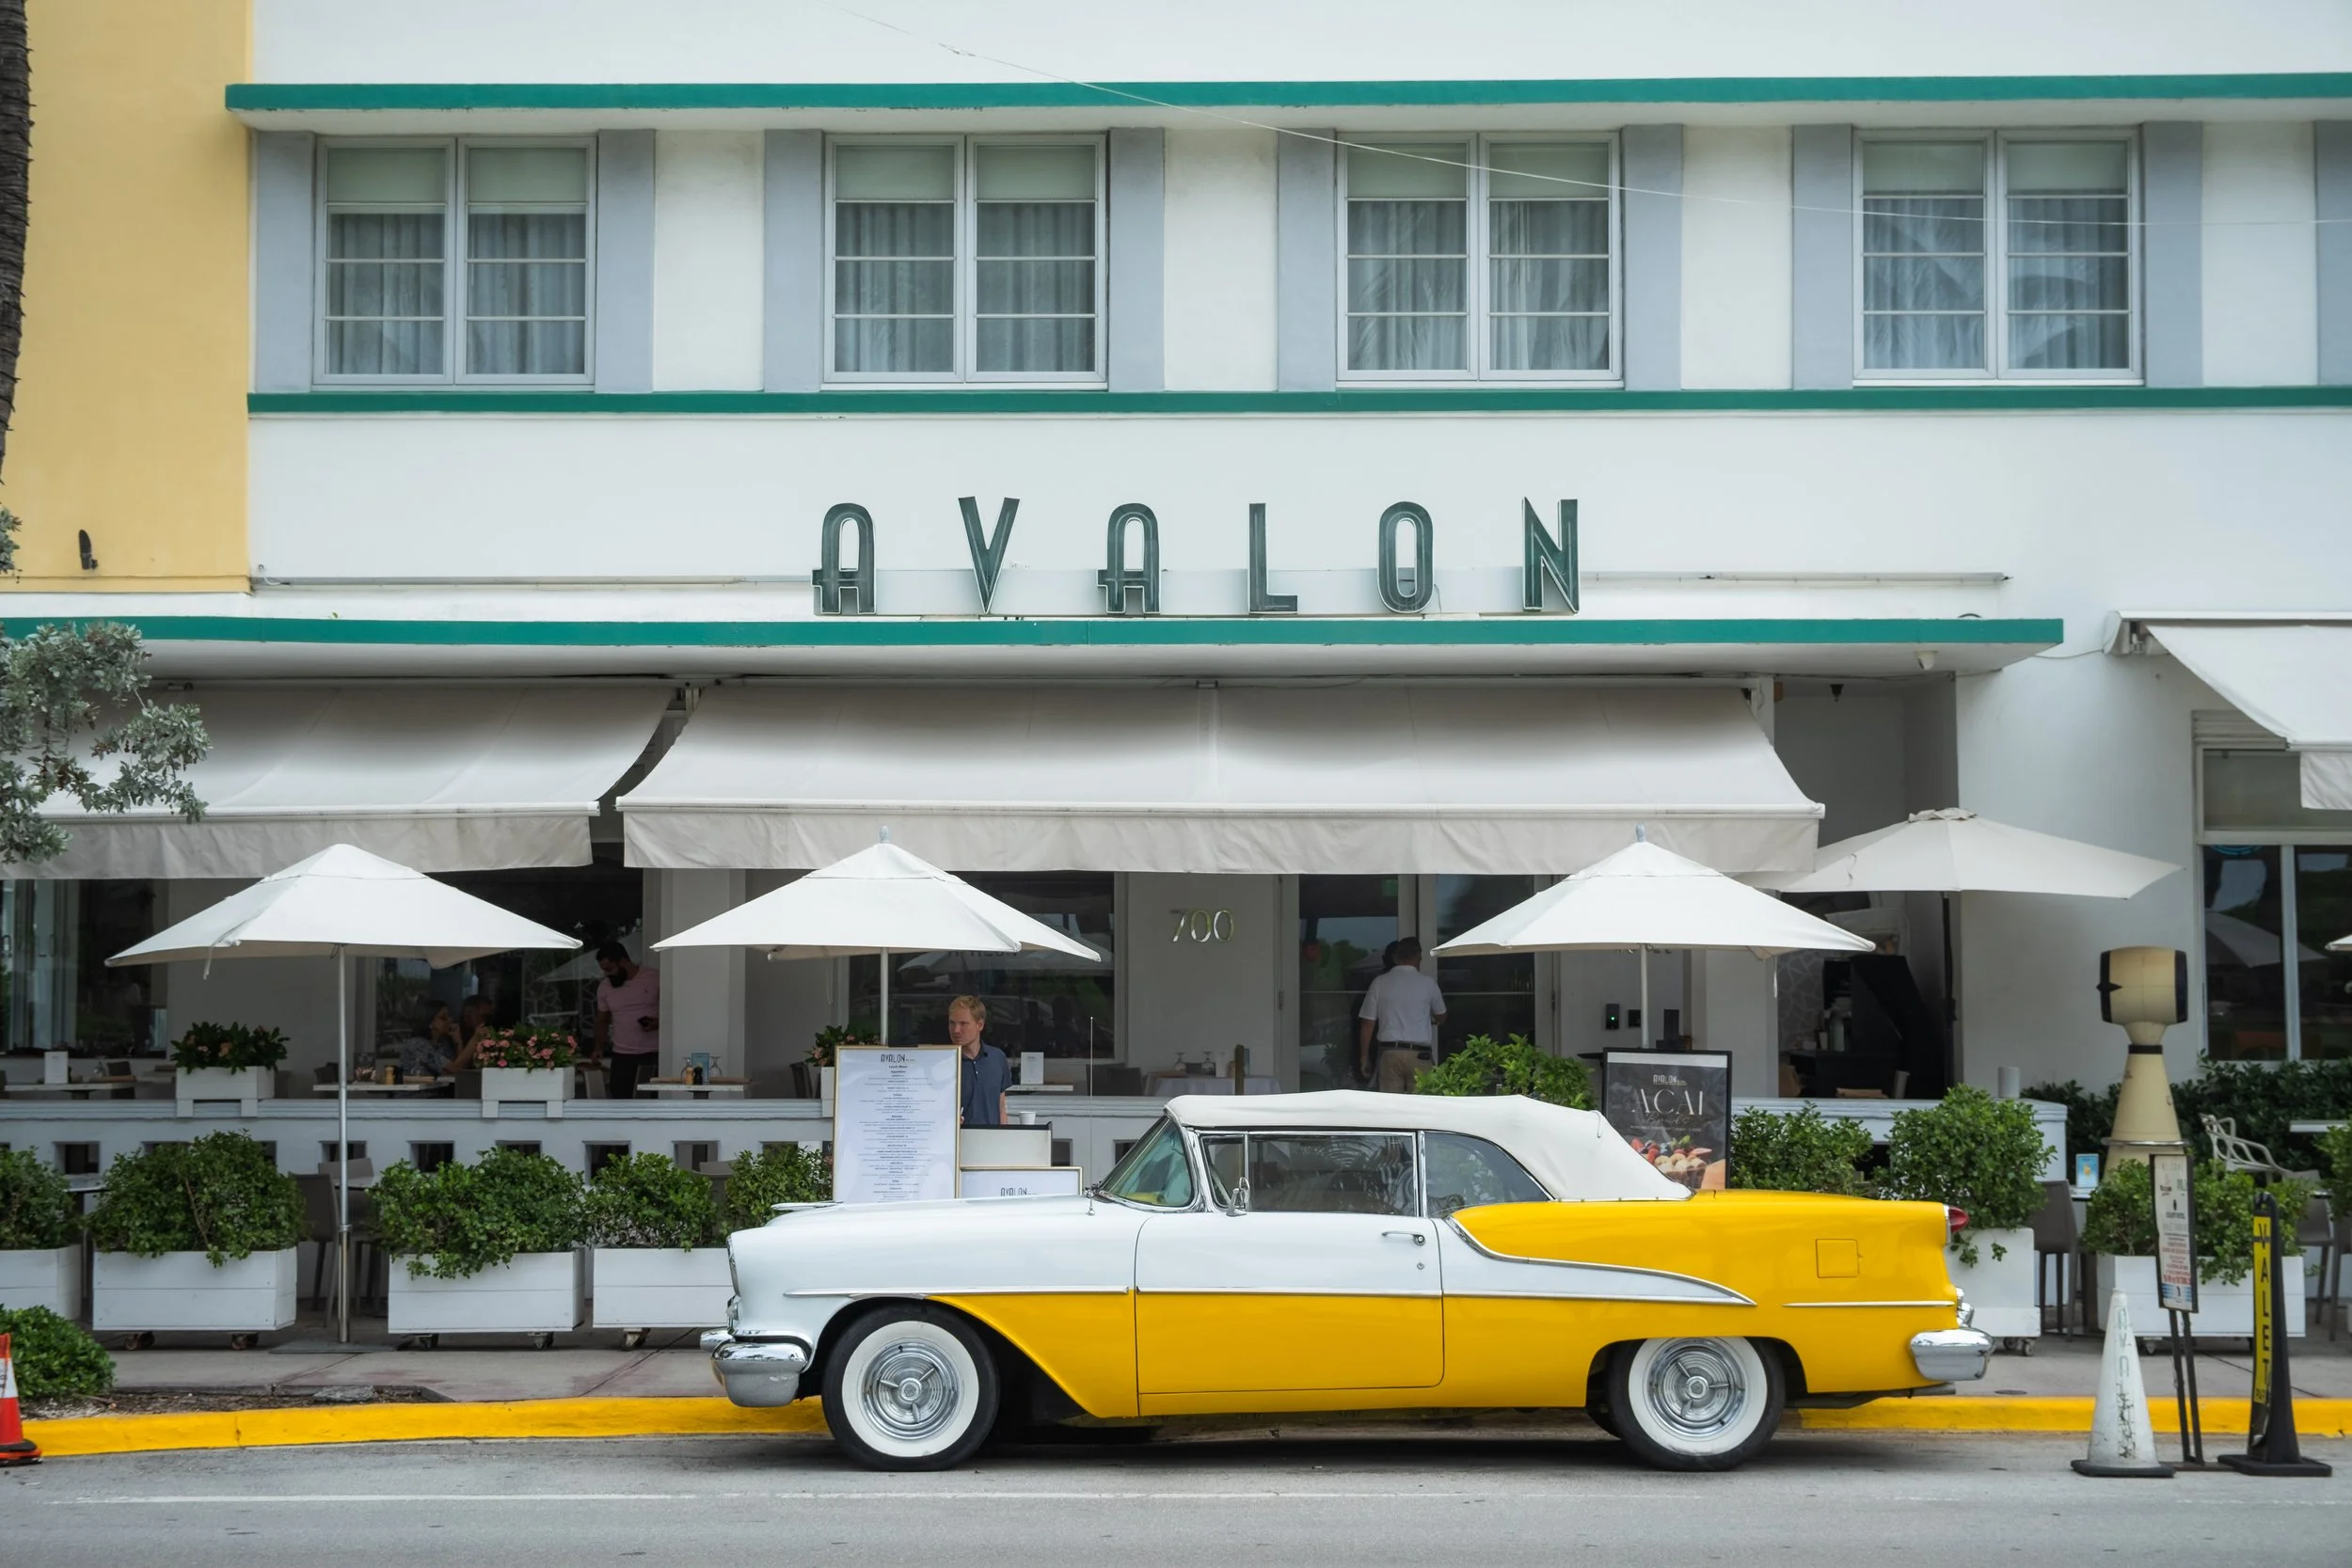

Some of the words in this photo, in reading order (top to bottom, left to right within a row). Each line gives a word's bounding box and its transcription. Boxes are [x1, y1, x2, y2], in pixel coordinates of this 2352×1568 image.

[812, 497, 1580, 614] AVALON
[1168, 909, 1234, 942] 700
[881, 1053, 906, 1063] AVALON
[1653, 1074, 1677, 1084] AVALON
[1631, 1088, 1704, 1116] ACAI
[2258, 1222, 2271, 1386] VALET
